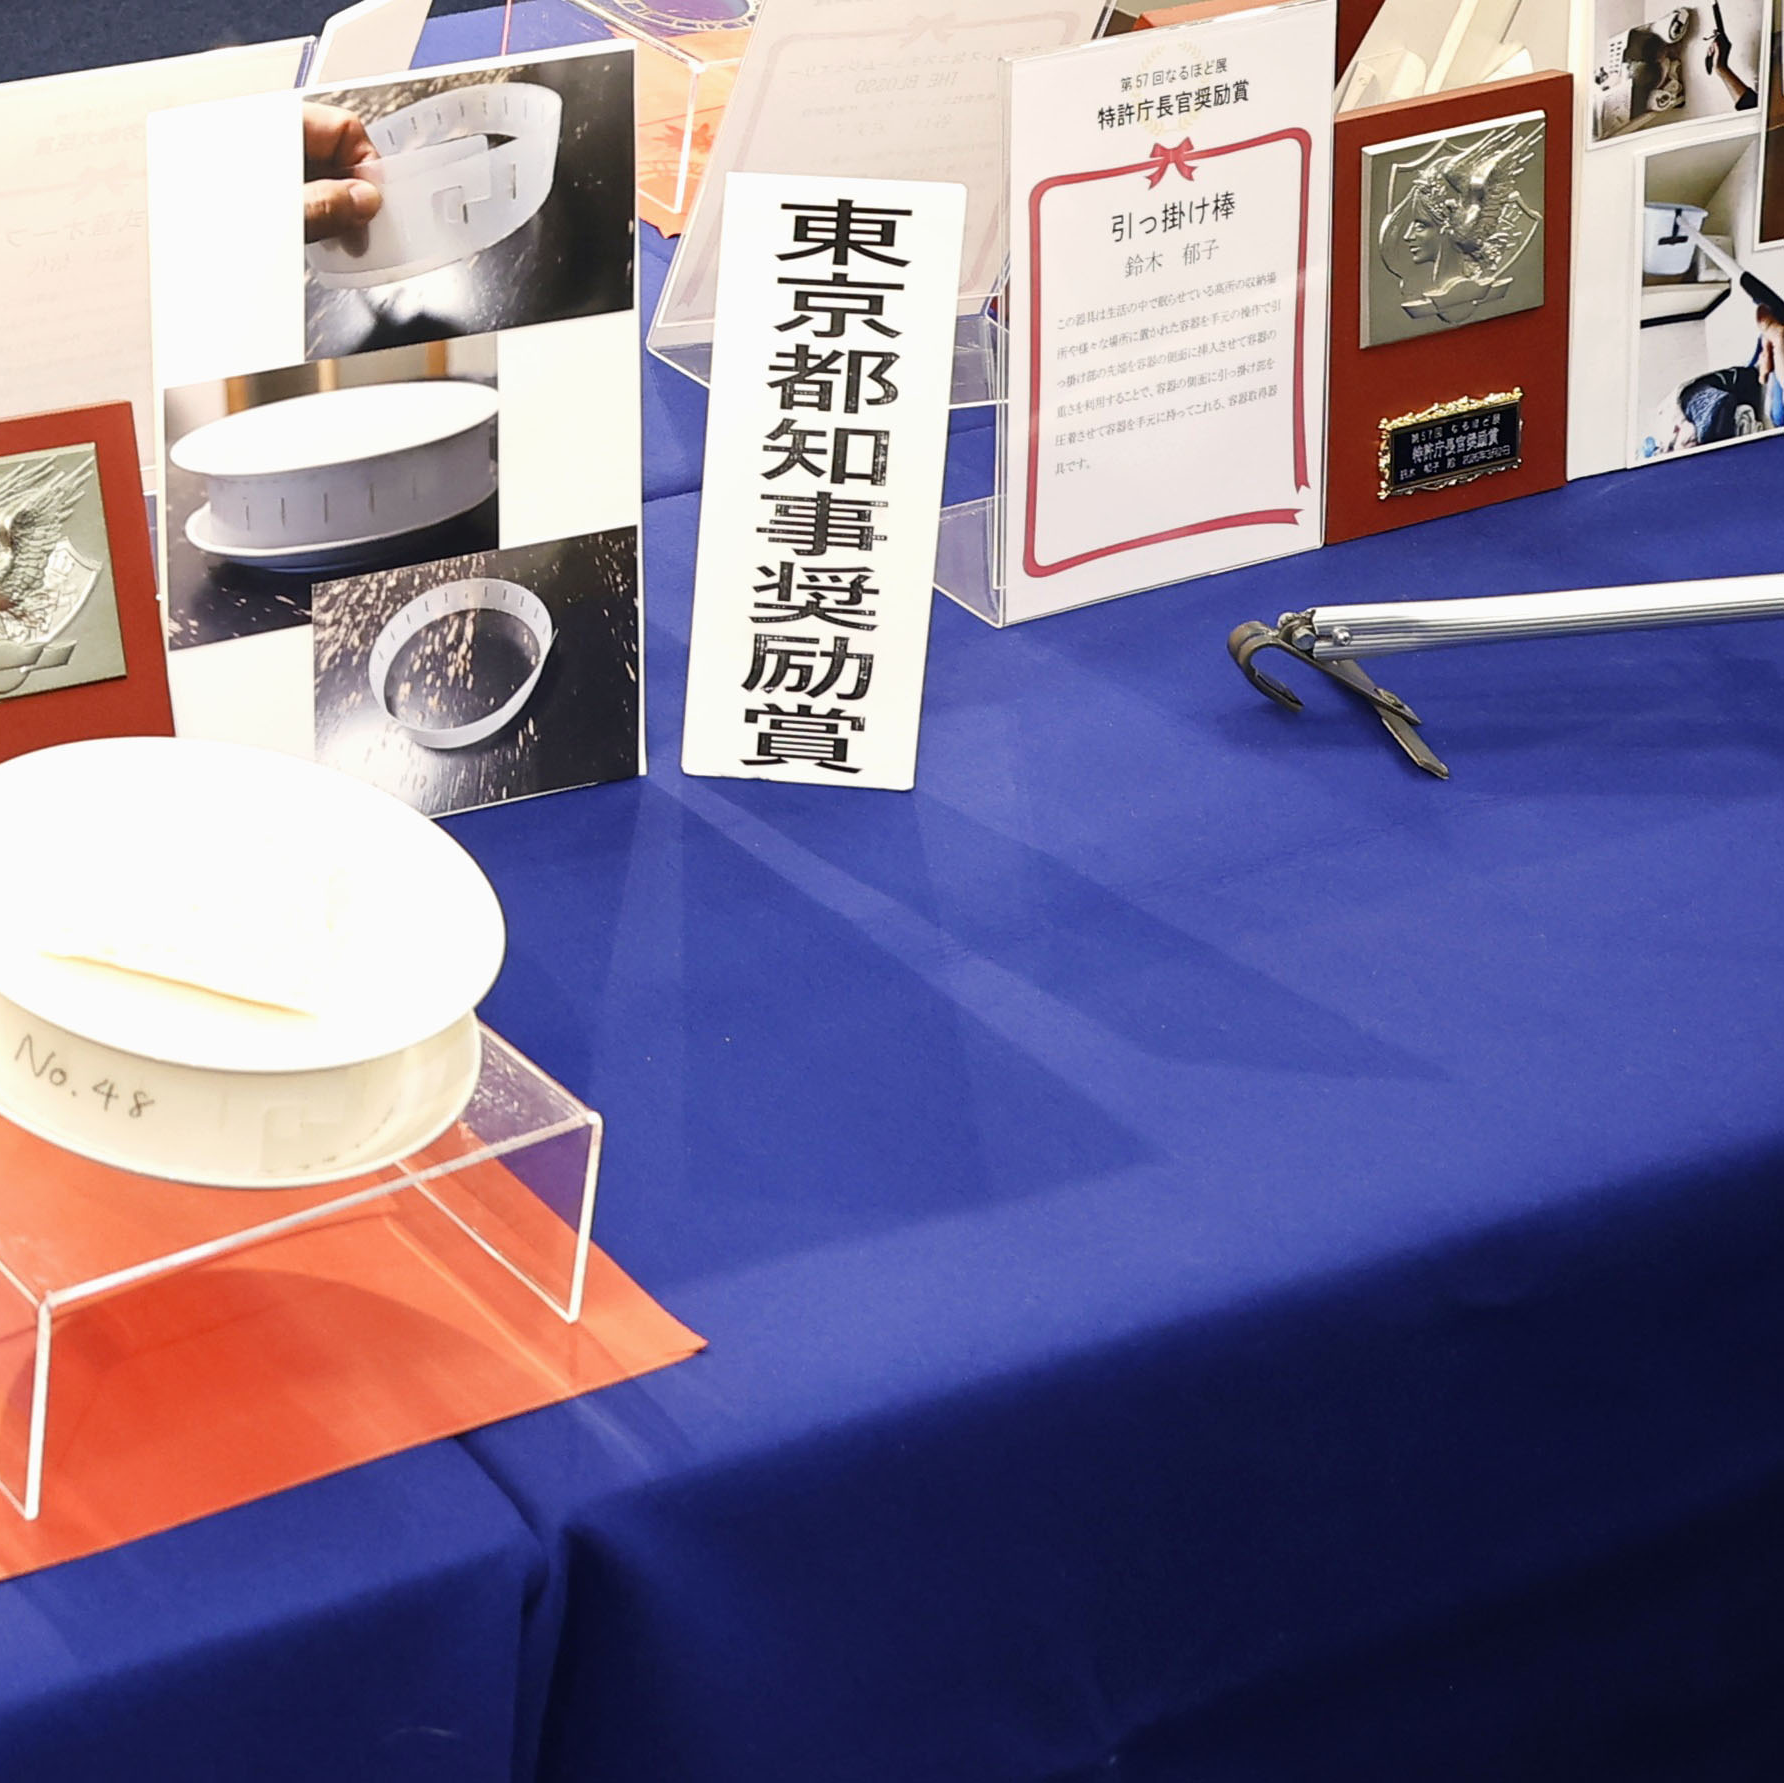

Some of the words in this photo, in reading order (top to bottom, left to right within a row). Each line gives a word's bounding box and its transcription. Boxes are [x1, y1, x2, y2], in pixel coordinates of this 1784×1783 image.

[1120, 55, 1227, 94] 第57回なるほど展
[1098, 76, 1250, 132] 特許庁長官奨励賞
[1111, 188, 1235, 245] 引っ掛け棒
[1125, 249, 1162, 278] 鈴木
[1183, 236, 1219, 265] 郁子
[741, 198, 914, 773] 東京都知事奨励賞
